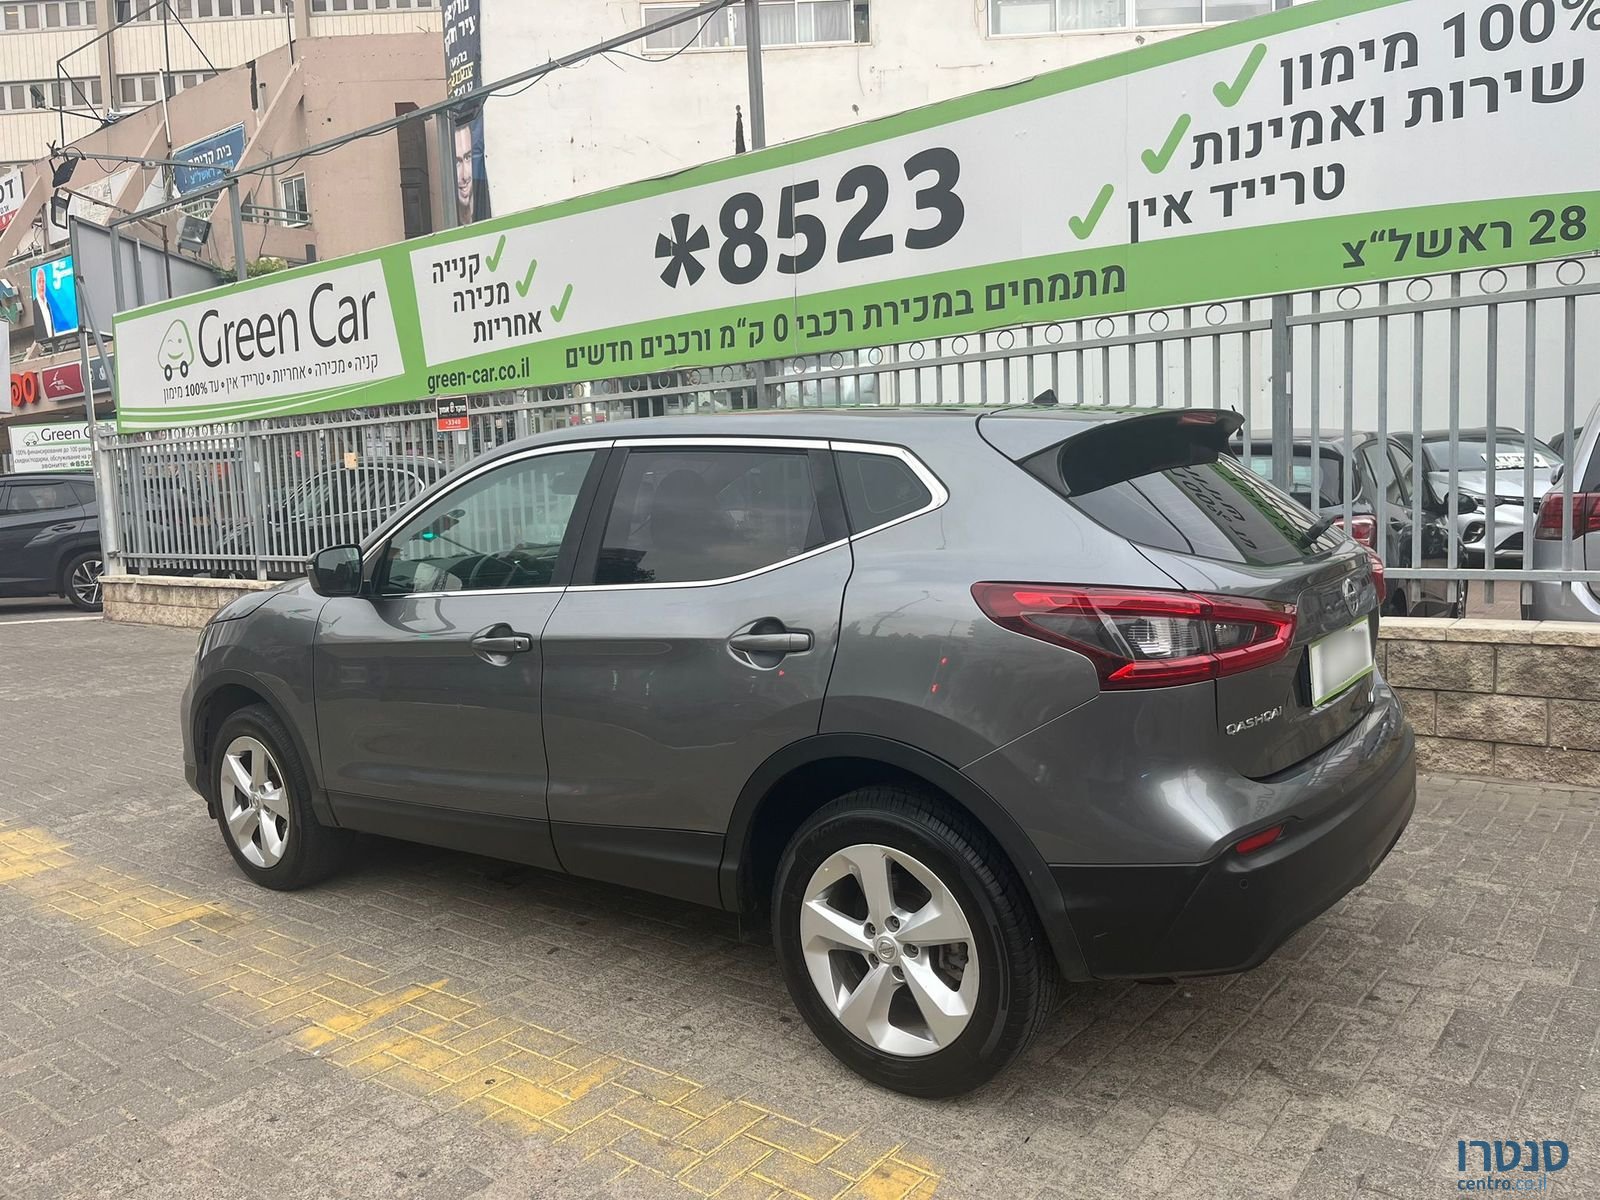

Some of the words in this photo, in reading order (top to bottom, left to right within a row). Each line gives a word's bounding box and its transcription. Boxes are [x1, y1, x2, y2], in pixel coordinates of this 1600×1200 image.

[1280, 31, 1419, 106] מימון
[1404, 58, 1585, 128] שירות
[1190, 95, 1384, 170] ואמינות
[1210, 162, 1345, 218] טרייד
[1128, 190, 1193, 244] אין
[1529, 205, 1587, 246] 28
[432, 253, 480, 284] קנייה
[453, 281, 510, 313] מכירה
[985, 264, 1125, 312] מתמחים
[198, 308, 300, 368] Green
[309, 282, 376, 348] Car
[796, 307, 853, 339] רכבי
[862, 289, 974, 330] במכירת
[473, 310, 542, 343] אחריות
[773, 313, 788, 342] 0
[565, 340, 633, 369] חדשים
[640, 328, 711, 359] ורכבים
[272, 365, 306, 384] אחריות
[315, 359, 346, 377] מכירה
[355, 354, 378, 373] קניה
[428, 357, 530, 393] green-car.co.il
[163, 385, 183, 404] מימון
[185, 381, 207, 397] 100%
[208, 380, 220, 393] עד
[225, 375, 239, 394] אין
[240, 372, 264, 387] טרייד
[41, 428, 81, 441] Green
